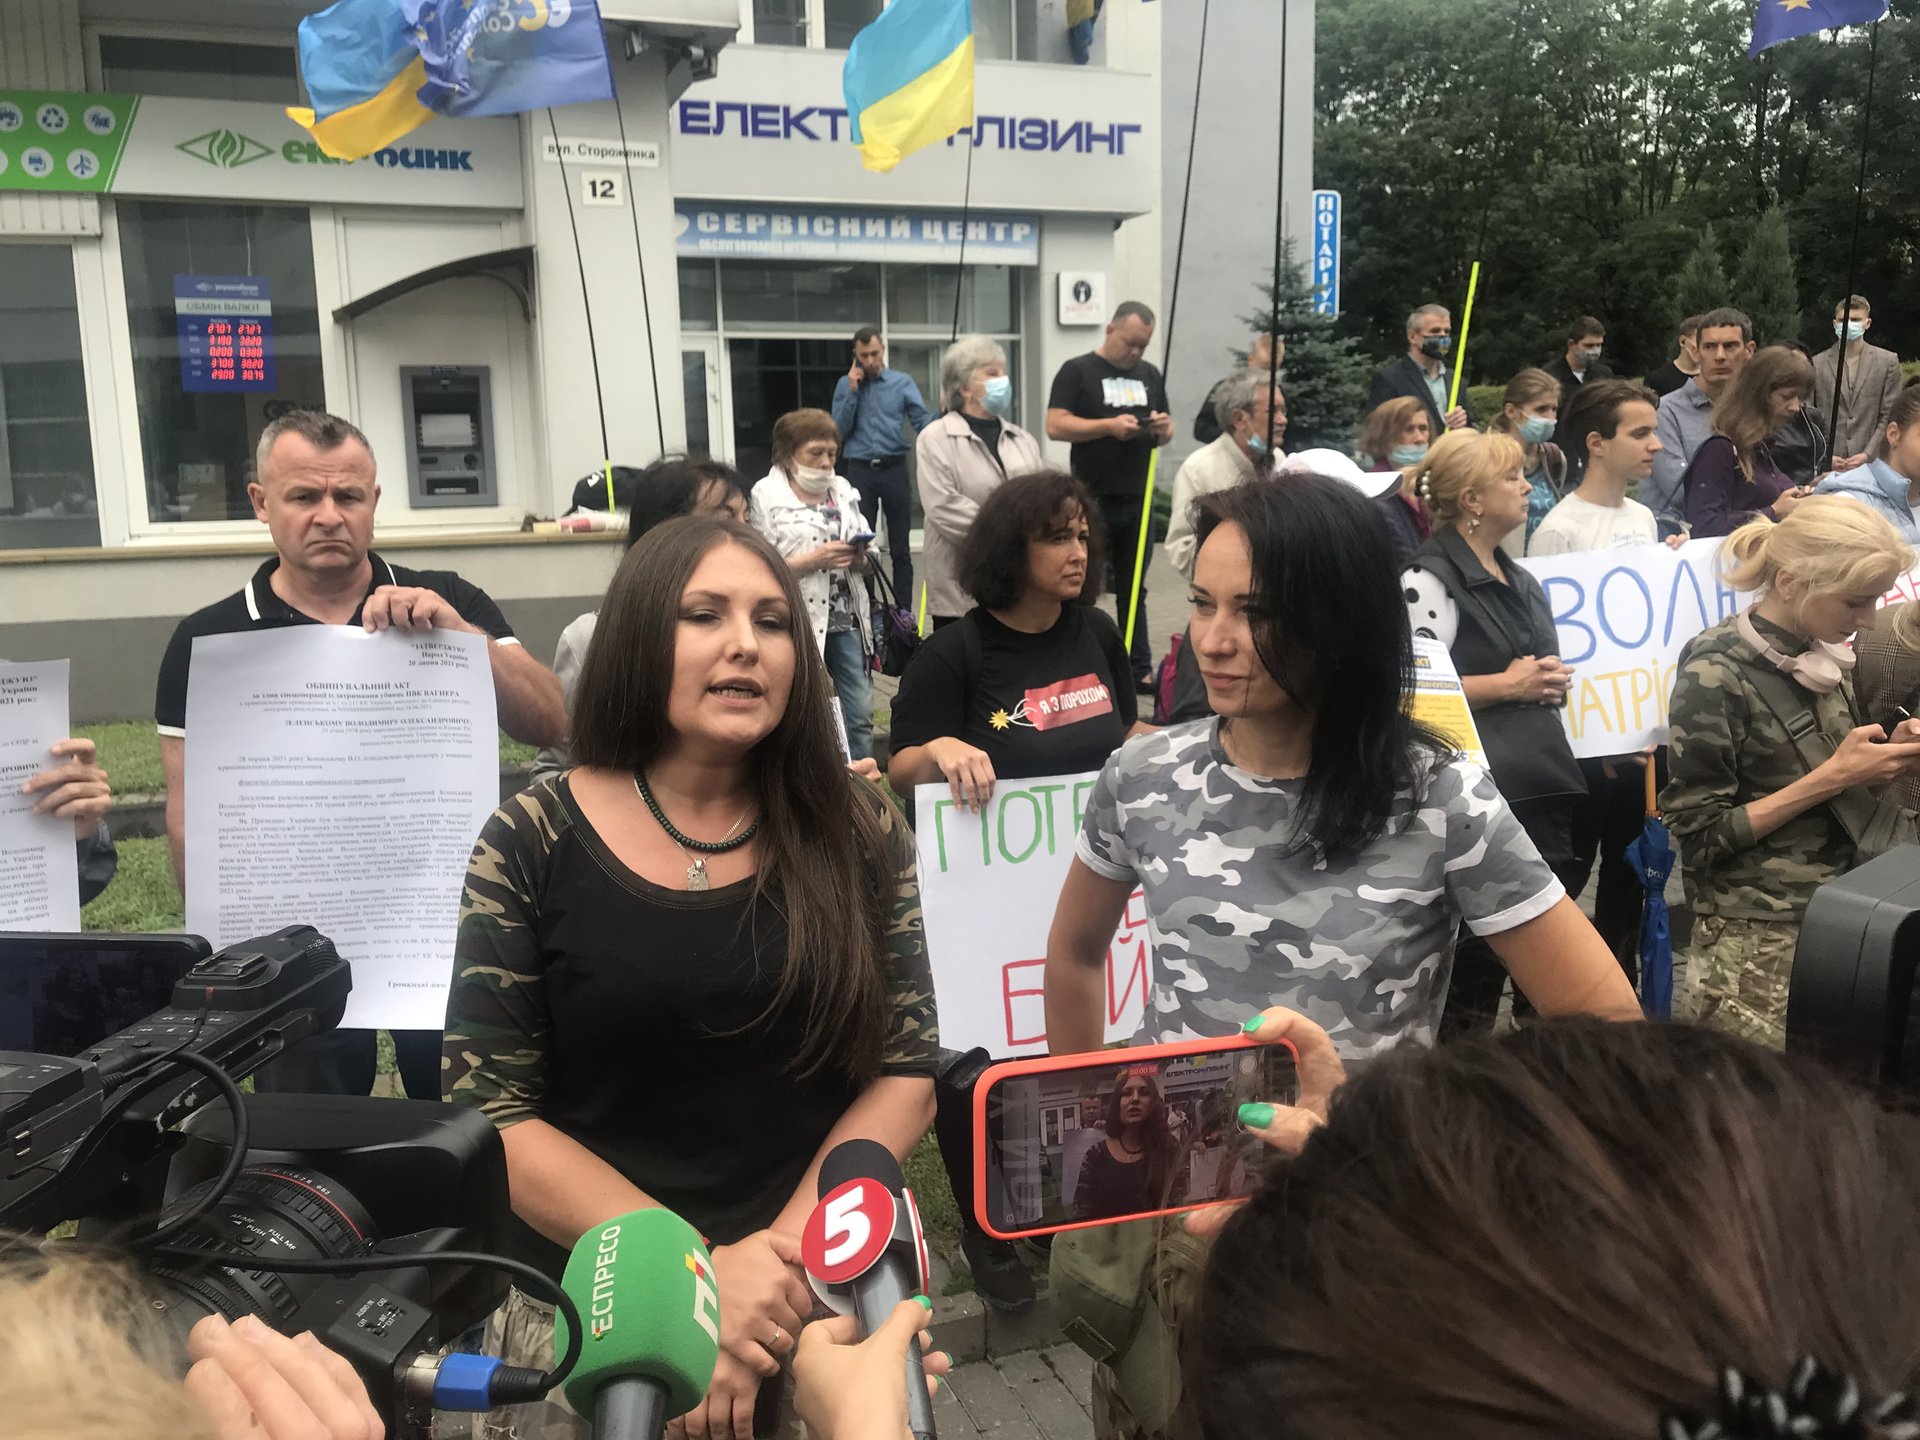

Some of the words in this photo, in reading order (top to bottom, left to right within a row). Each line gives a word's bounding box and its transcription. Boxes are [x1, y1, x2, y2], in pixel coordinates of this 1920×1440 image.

[547, 143, 575, 157] вул.
[578, 143, 655, 160] Стороженка
[589, 179, 615, 198] 12
[697, 211, 911, 240] СЕРВІСНИЙ
[922, 219, 1031, 243] ЦЕНТР
[394, 681, 411, 690] АКТ
[1039, 700, 1052, 716] Я
[1059, 684, 1109, 712] ПОРОХОМ
[246, 1224, 267, 1237] PUSH
[824, 1185, 872, 1267] 5
[268, 1228, 284, 1242] FULL
[284, 1240, 296, 1250] MF
[591, 1223, 622, 1340] ЕСПРЕСО
